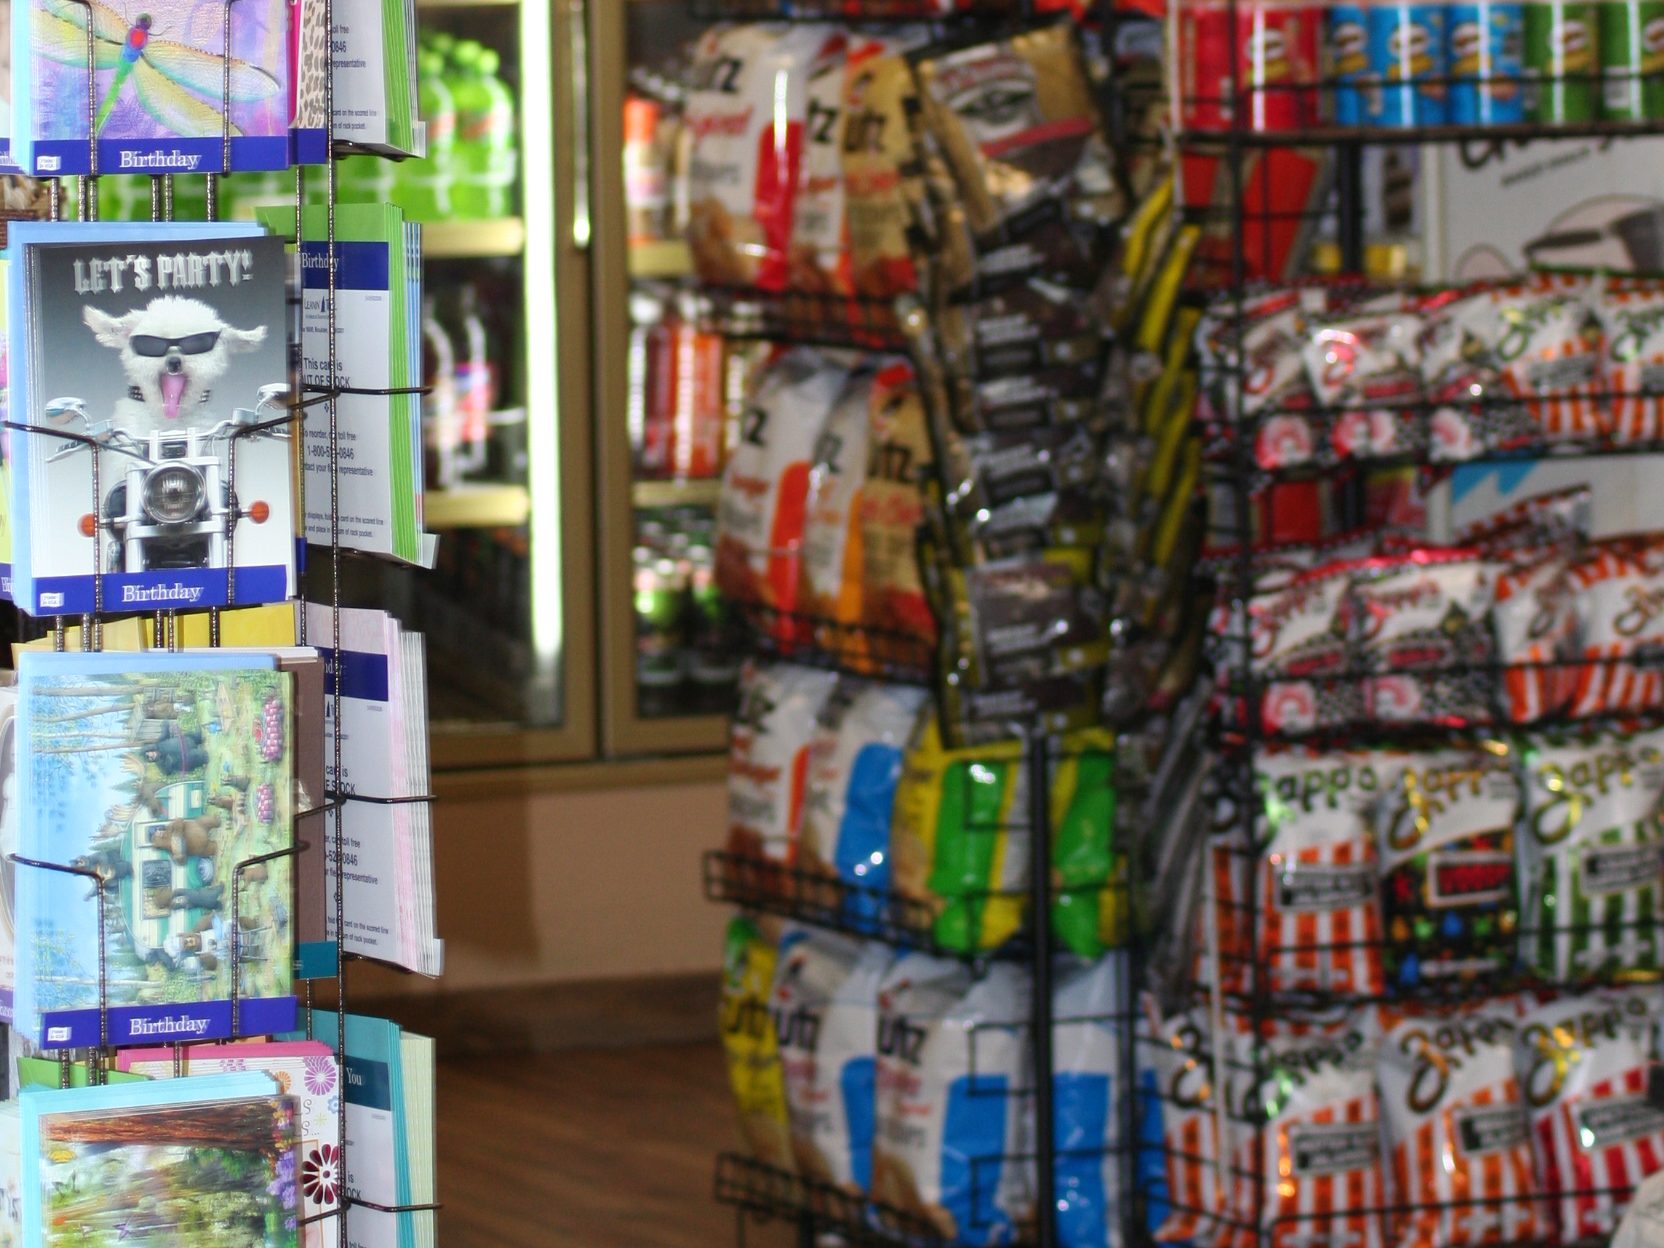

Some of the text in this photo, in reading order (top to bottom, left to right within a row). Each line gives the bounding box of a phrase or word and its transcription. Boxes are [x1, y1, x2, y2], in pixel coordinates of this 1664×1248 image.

[333, 59, 366, 70] epresentative
[119, 150, 202, 170] Birthday
[302, 252, 340, 272] Birthdy
[73, 249, 253, 296] LET'S PARTY!
[303, 357, 318, 370] This
[336, 358, 343, 371] is
[325, 376, 351, 389] SOCK
[307, 445, 355, 460] 1-800-5-0846
[122, 582, 204, 603] Birthday
[342, 765, 349, 777] is
[331, 780, 356, 795] SOCK
[129, 1015, 212, 1035] Birthday
[346, 1066, 363, 1086] You
